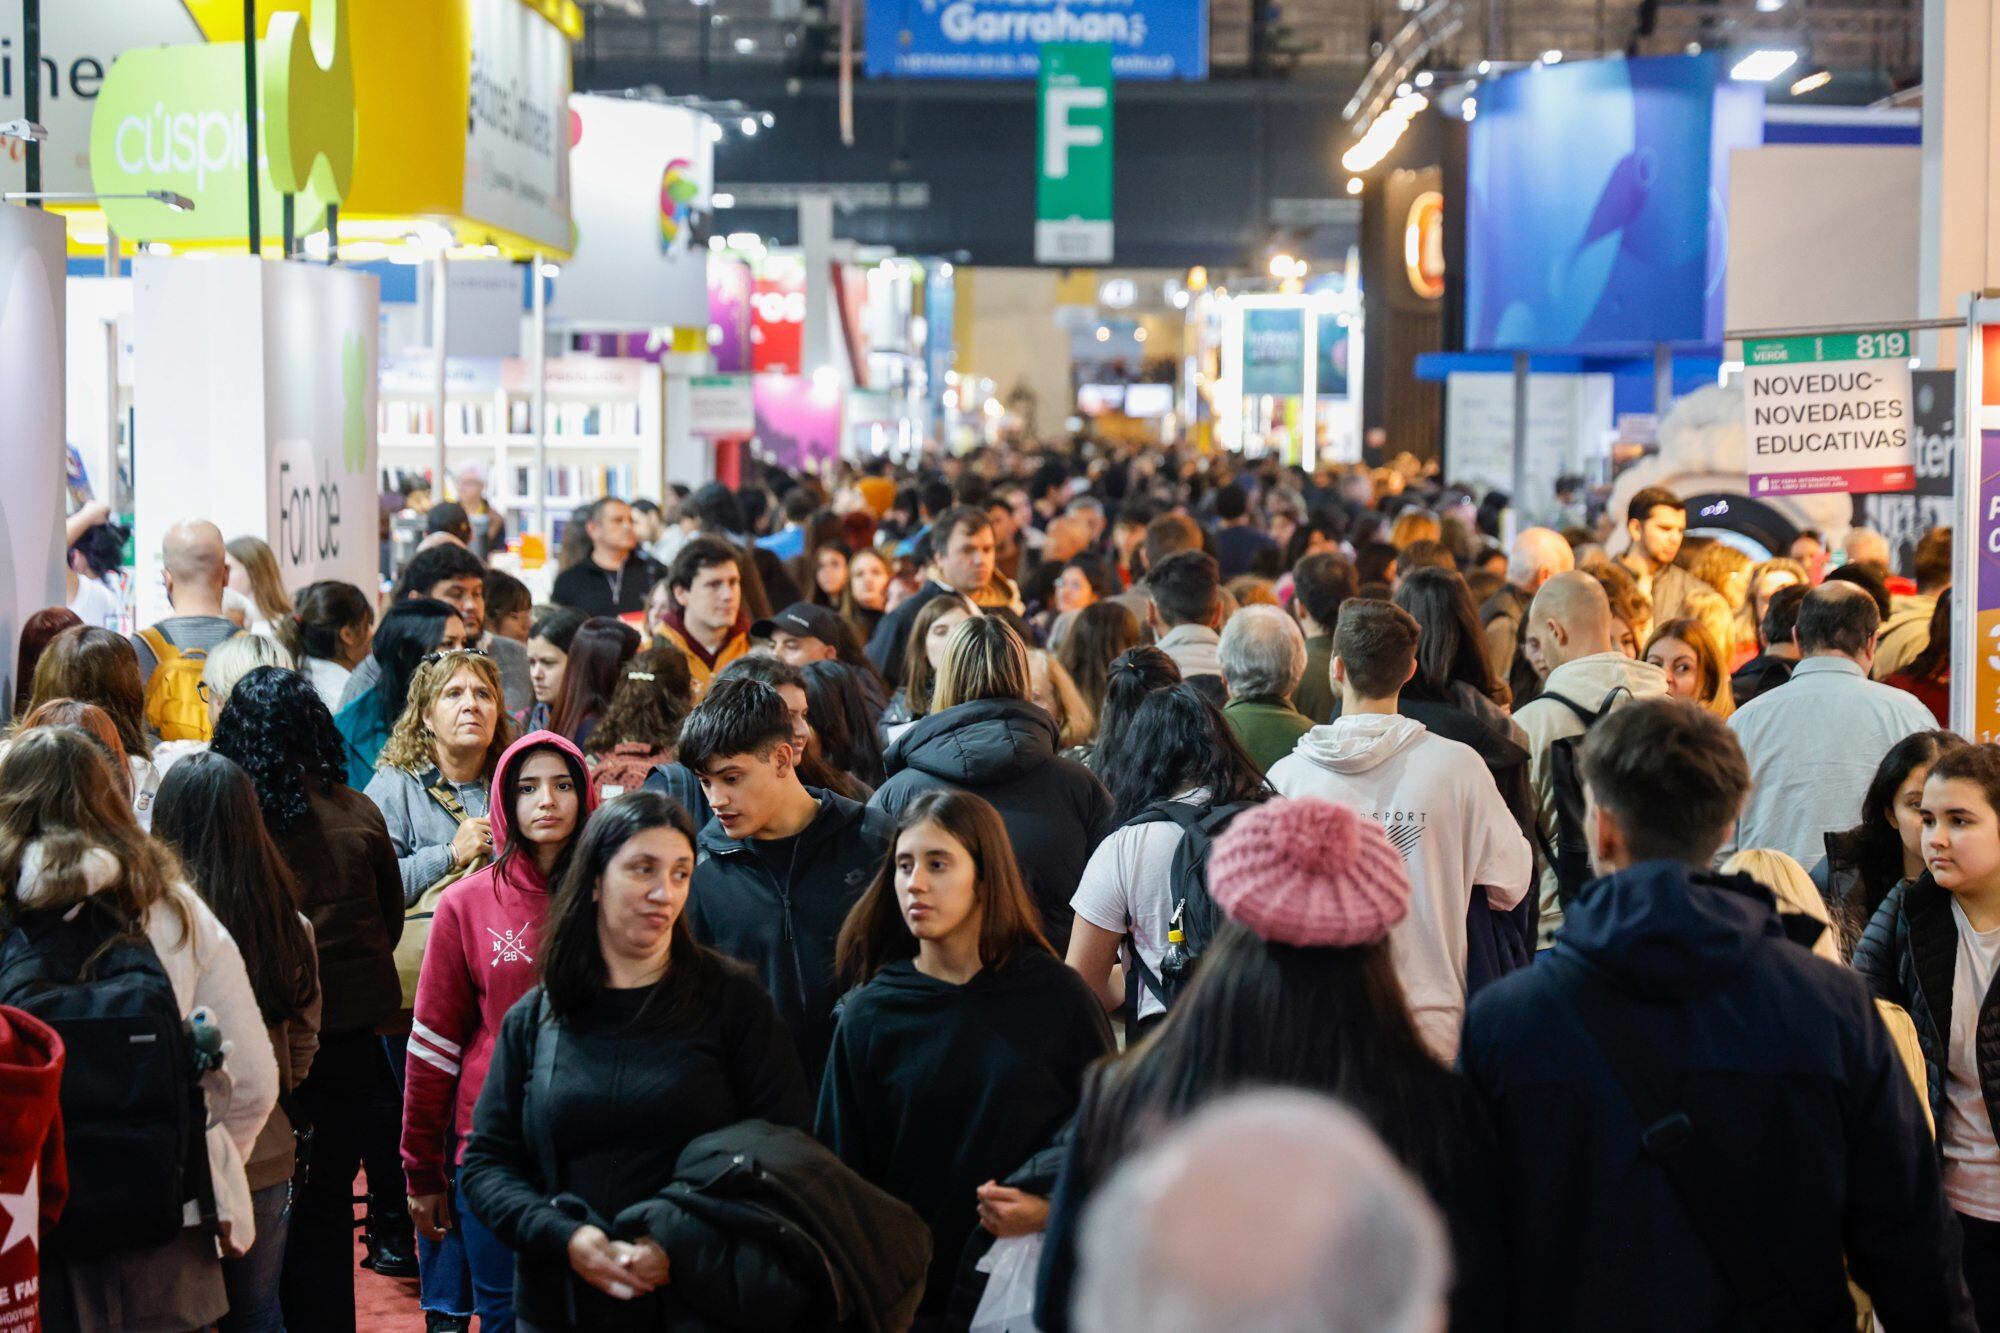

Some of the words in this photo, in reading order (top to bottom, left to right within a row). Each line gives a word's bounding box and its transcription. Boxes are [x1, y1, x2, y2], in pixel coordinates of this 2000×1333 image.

[941, 3, 1127, 42] Garrahan
[1044, 86, 1107, 179] F
[1753, 349, 1789, 361] VERDE
[1856, 332, 1906, 359] 819
[1753, 371, 1884, 397] NOVEDUC-
[1755, 399, 1904, 425] NOVEDADES
[1756, 428, 1908, 455] EDUCATIVAS
[493, 941, 502, 951] N
[518, 939, 525, 949] L
[505, 930, 513, 939] S
